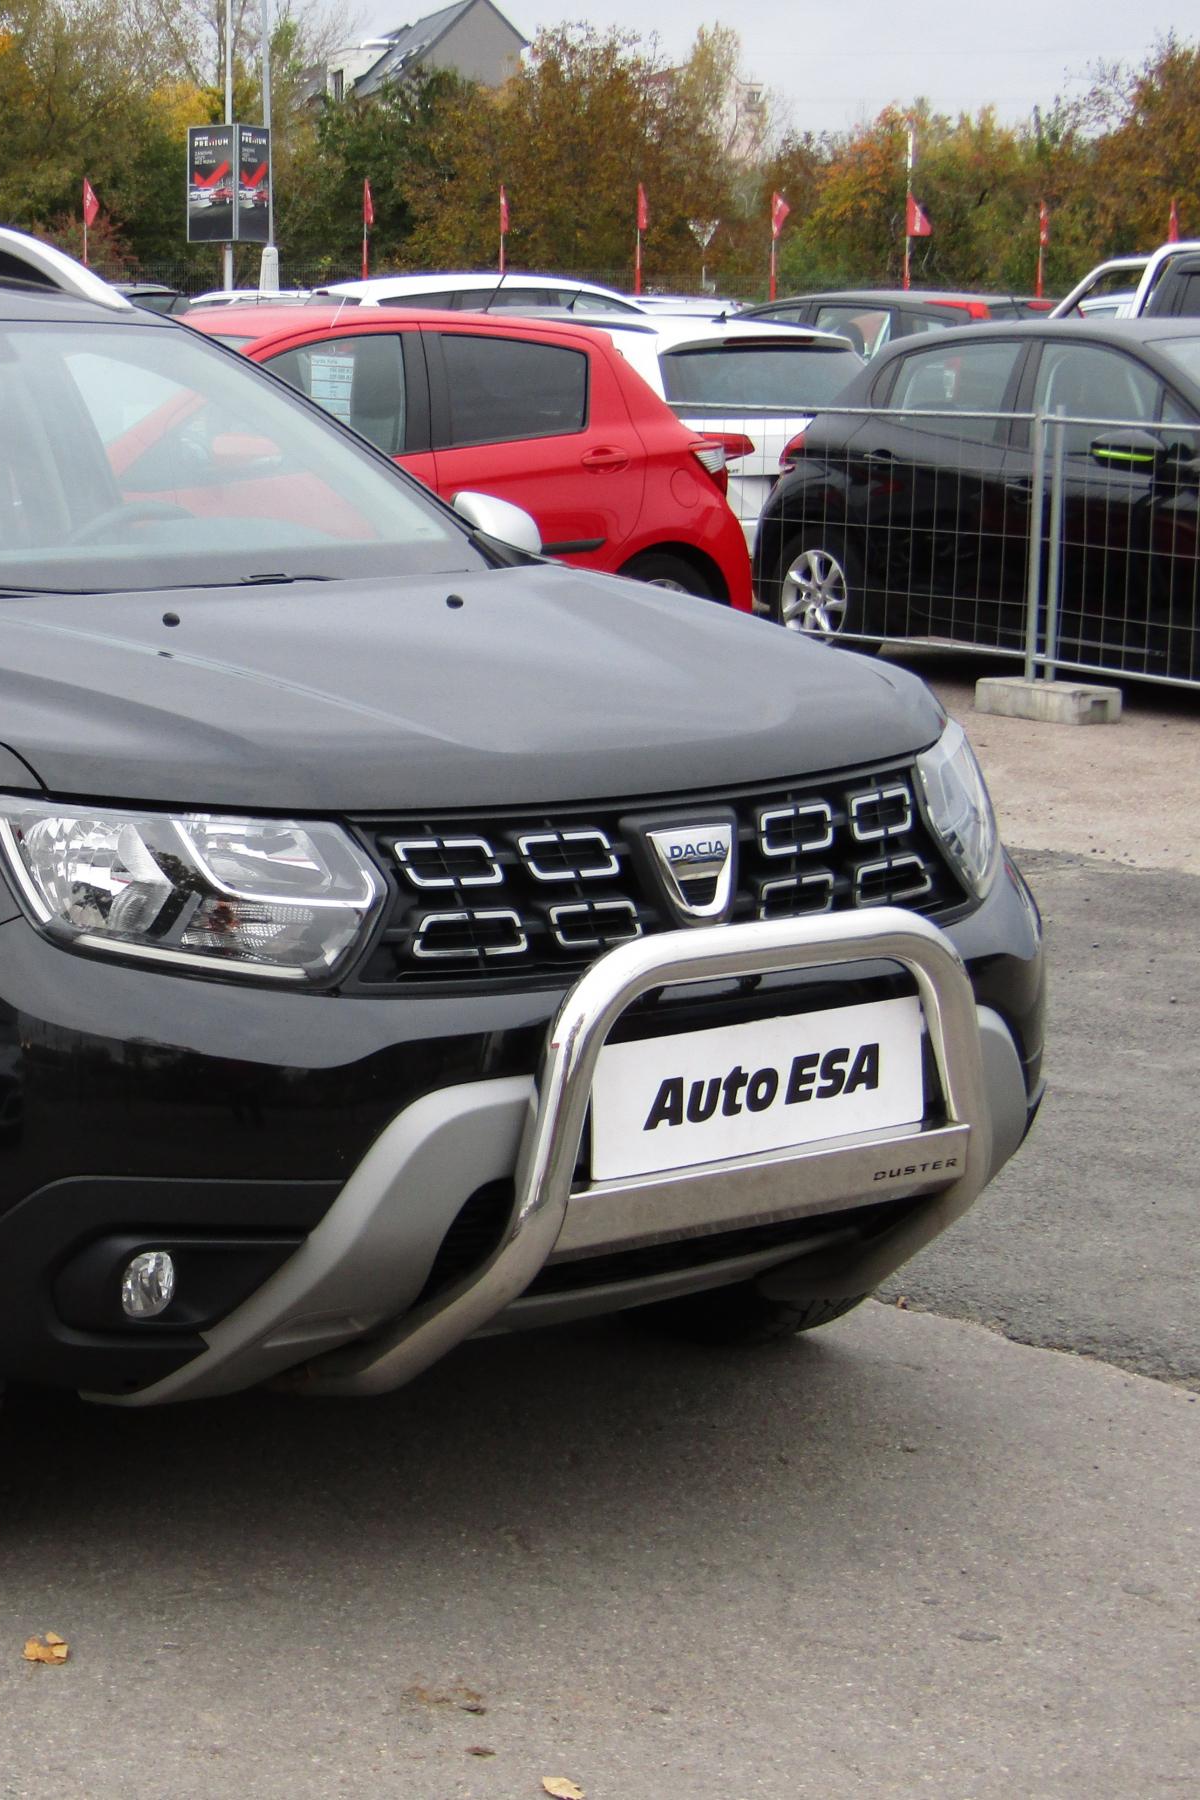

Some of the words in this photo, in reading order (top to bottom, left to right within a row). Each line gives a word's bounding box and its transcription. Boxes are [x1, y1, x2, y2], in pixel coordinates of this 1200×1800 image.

[670, 840, 726, 858] DACIA
[643, 1065, 779, 1131] Auto
[784, 1043, 880, 1105] ESA
[873, 1158, 957, 1181] DUSTER
